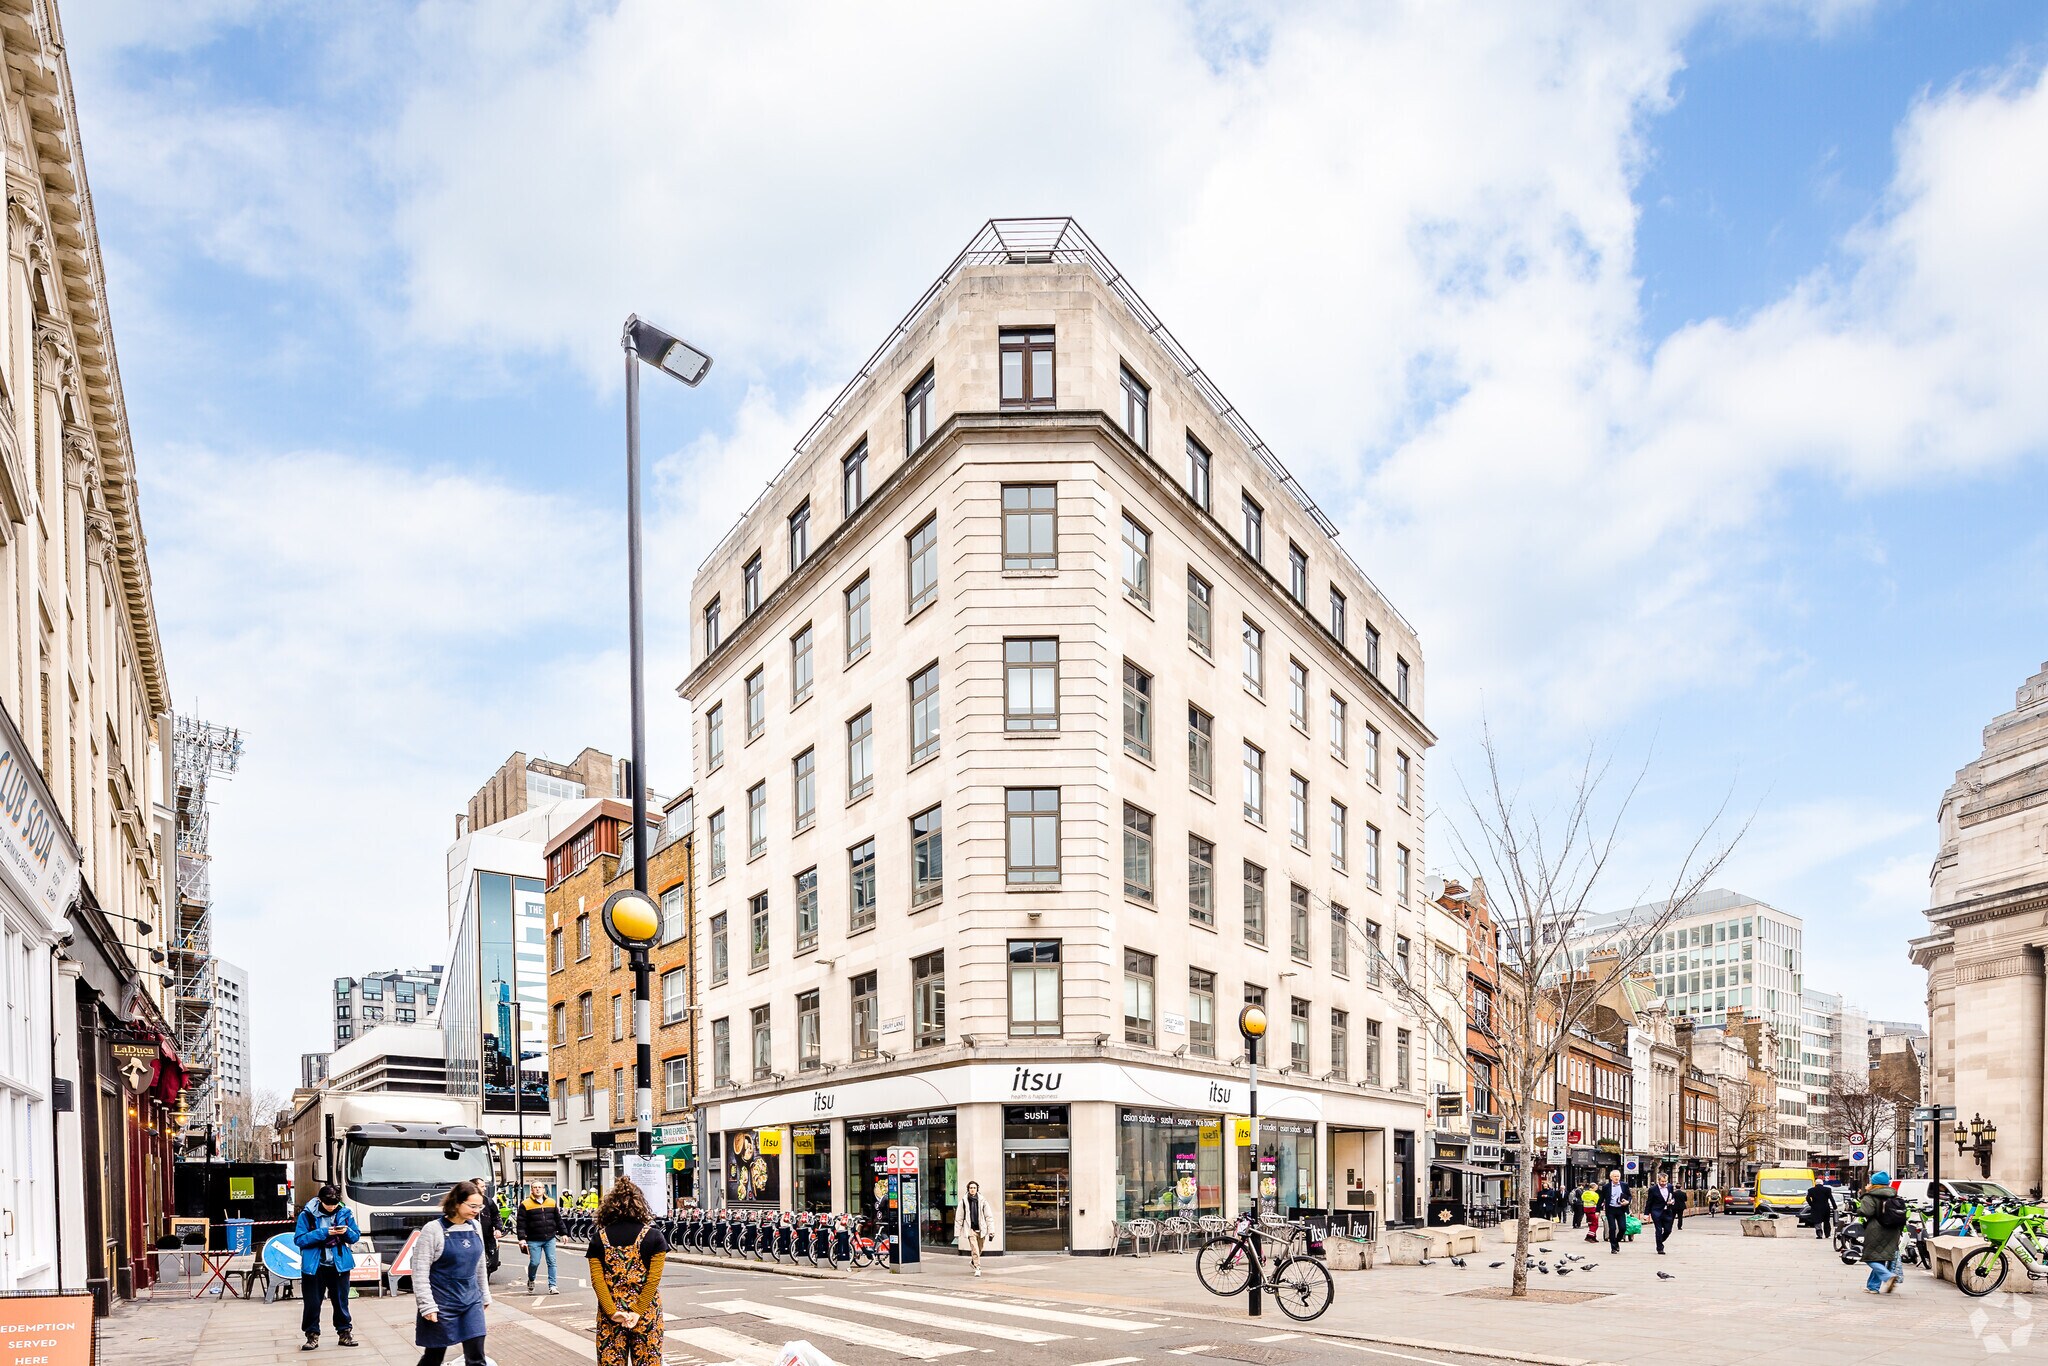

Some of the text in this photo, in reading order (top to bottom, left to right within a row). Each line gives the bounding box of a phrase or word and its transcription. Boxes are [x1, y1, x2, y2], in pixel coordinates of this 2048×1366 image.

[0, 751, 55, 871] LUB SODA
[113, 1044, 154, 1055] LaDuca
[1012, 1066, 1062, 1091] itsu
[1209, 1081, 1231, 1103] itsu
[814, 1091, 834, 1111] itsu
[1024, 1110, 1049, 1120] sushi
[1123, 1113, 1138, 1122] asian
[1138, 1114, 1155, 1123] salads
[1160, 1115, 1174, 1125] sushi
[1177, 1118, 1192, 1127] soups
[852, 1116, 949, 1132] soups rice bowls gyoza hot noodles
[532, 1141, 543, 1152] AT
[763, 1138, 778, 1147] itsu
[874, 1162, 882, 1172] for
[1176, 1160, 1196, 1170] for free
[1266, 1163, 1276, 1171] free
[1309, 1224, 1328, 1242] itsu
[1331, 1222, 1346, 1238] itsu
[1353, 1221, 1368, 1238] itsu
[2014, 1245, 2033, 1264] Lime
[8, 1339, 57, 1349] SERVED
[15, 1356, 48, 1366] HERE
